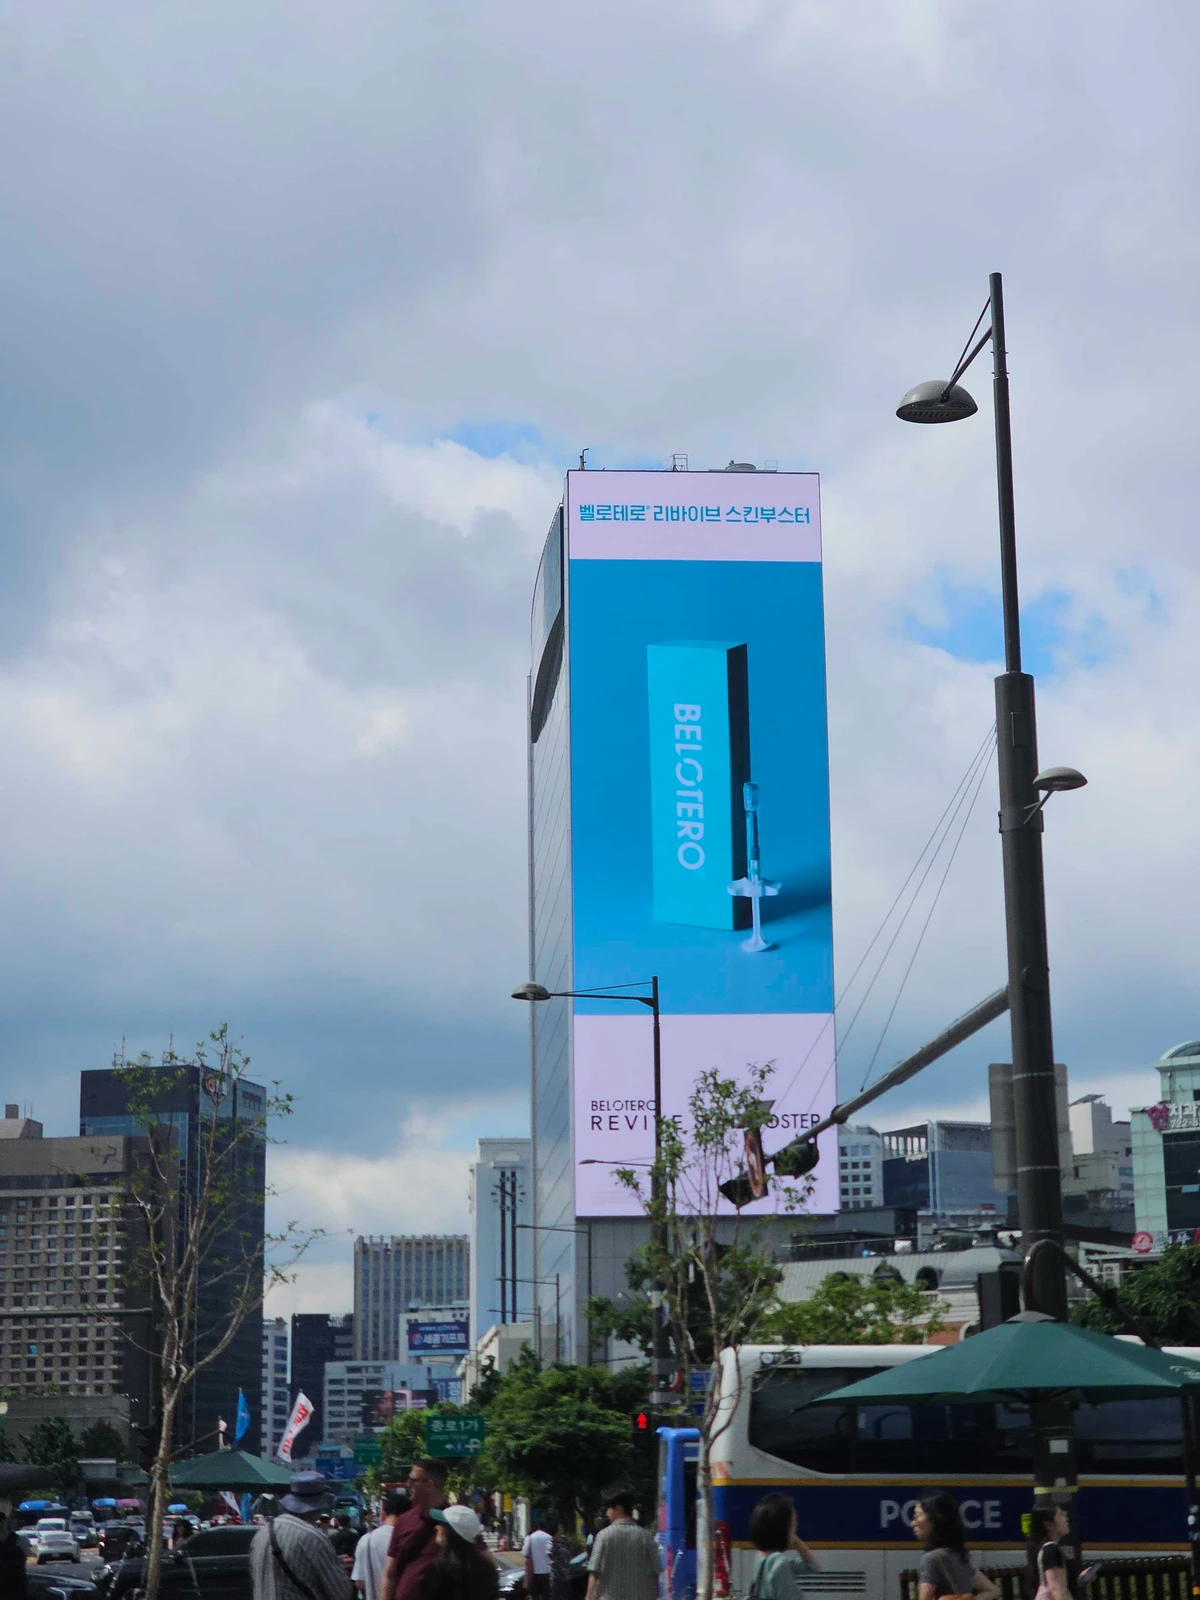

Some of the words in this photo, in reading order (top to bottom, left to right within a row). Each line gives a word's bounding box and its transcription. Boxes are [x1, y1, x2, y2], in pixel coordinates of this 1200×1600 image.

[653, 505, 722, 523] 리바이브
[725, 506, 811, 524] 스킨부스터
[673, 703, 706, 871] BELOTERO
[430, 1419, 480, 1432] 종로1가
